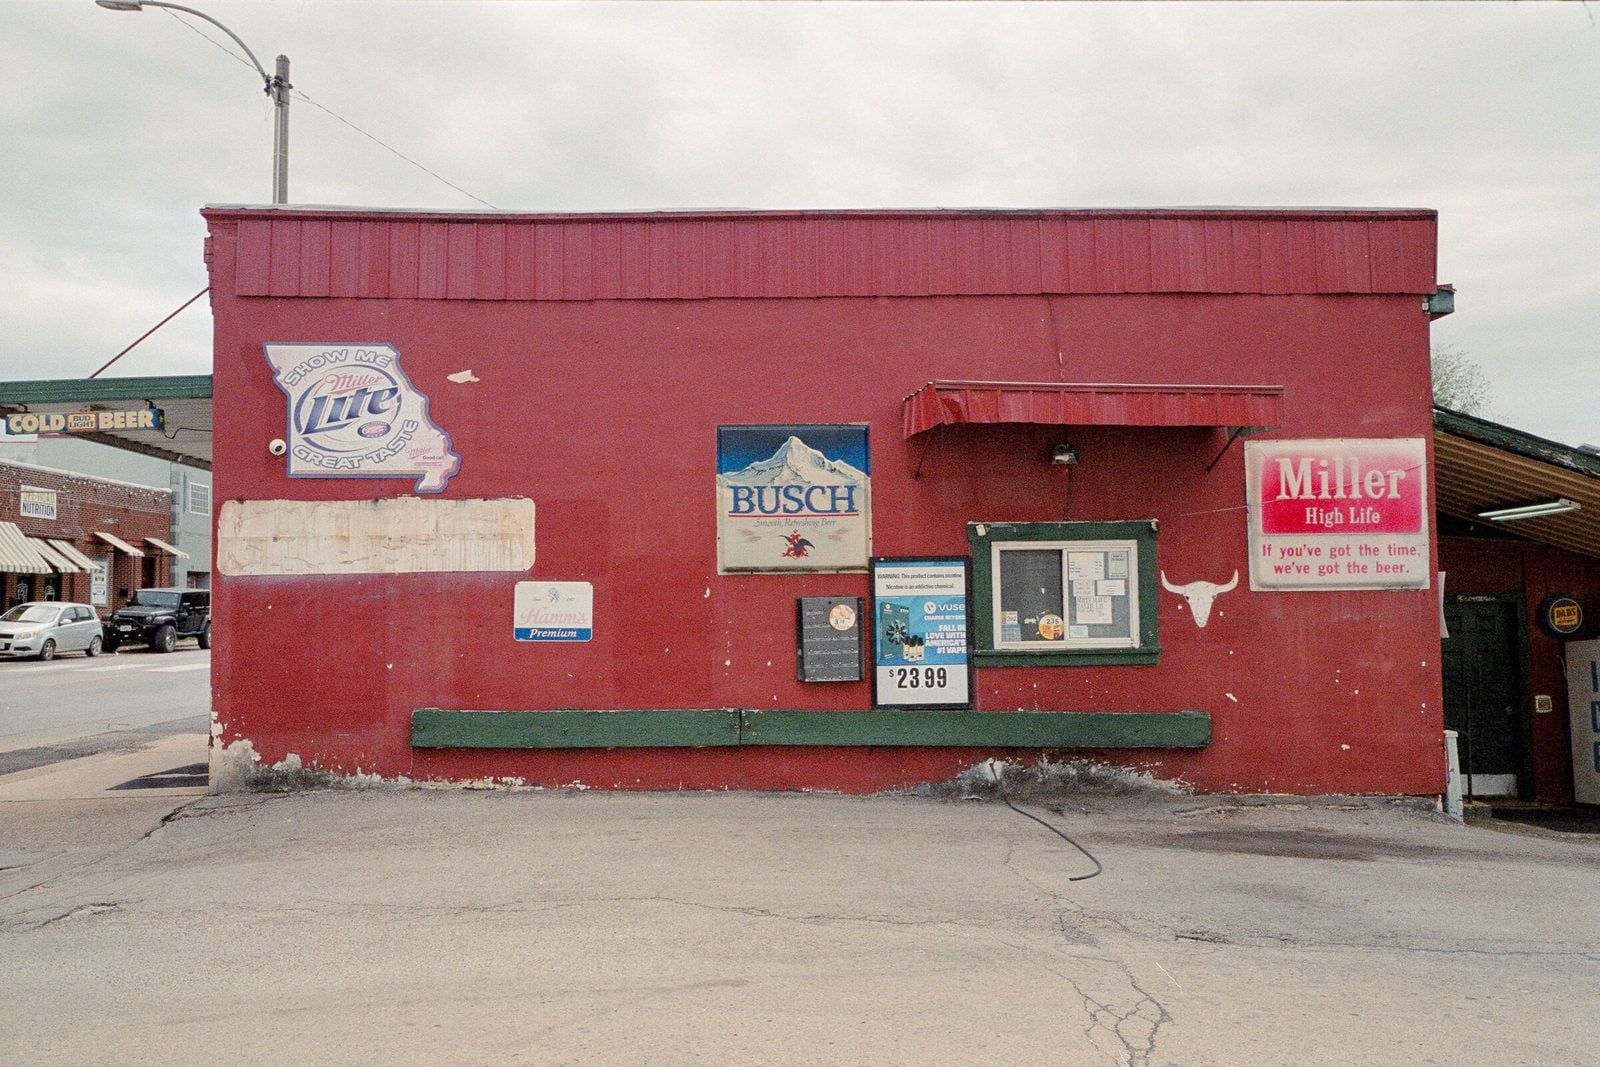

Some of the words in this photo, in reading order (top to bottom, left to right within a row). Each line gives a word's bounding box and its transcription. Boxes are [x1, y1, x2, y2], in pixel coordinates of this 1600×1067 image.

[284, 349, 348, 387] SHOW
[355, 349, 391, 368] ME
[325, 373, 385, 395] Miller
[100, 410, 154, 429] BEER
[300, 386, 399, 435] Lite
[9, 414, 66, 433] COLD
[293, 445, 365, 469] GREAT
[366, 419, 419, 464] TASTE
[1274, 457, 1407, 500] Miller
[727, 484, 858, 515] BUSCH
[22, 502, 54, 517] NUTRITION
[1305, 507, 1344, 527] High
[1350, 507, 1381, 524] Life
[784, 518, 820, 528] Refreshing
[821, 517, 837, 526] Beer
[1262, 544, 1272, 556] If
[1280, 545, 1322, 558] you've
[1329, 546, 1352, 559] got
[1359, 544, 1380, 555] the
[1387, 543, 1421, 558] time,
[1274, 562, 1310, 574] we've
[1318, 562, 1340, 577] got
[1347, 562, 1368, 574] the
[1376, 562, 1410, 574] beer.
[520, 606, 589, 625] Hamm's
[529, 628, 578, 639] Premium
[925, 631, 945, 640] LOVE
[946, 630, 966, 639] WITH
[938, 624, 957, 632] FALL
[925, 639, 966, 647] AMERICA'S
[947, 646, 967, 654] VAPE
